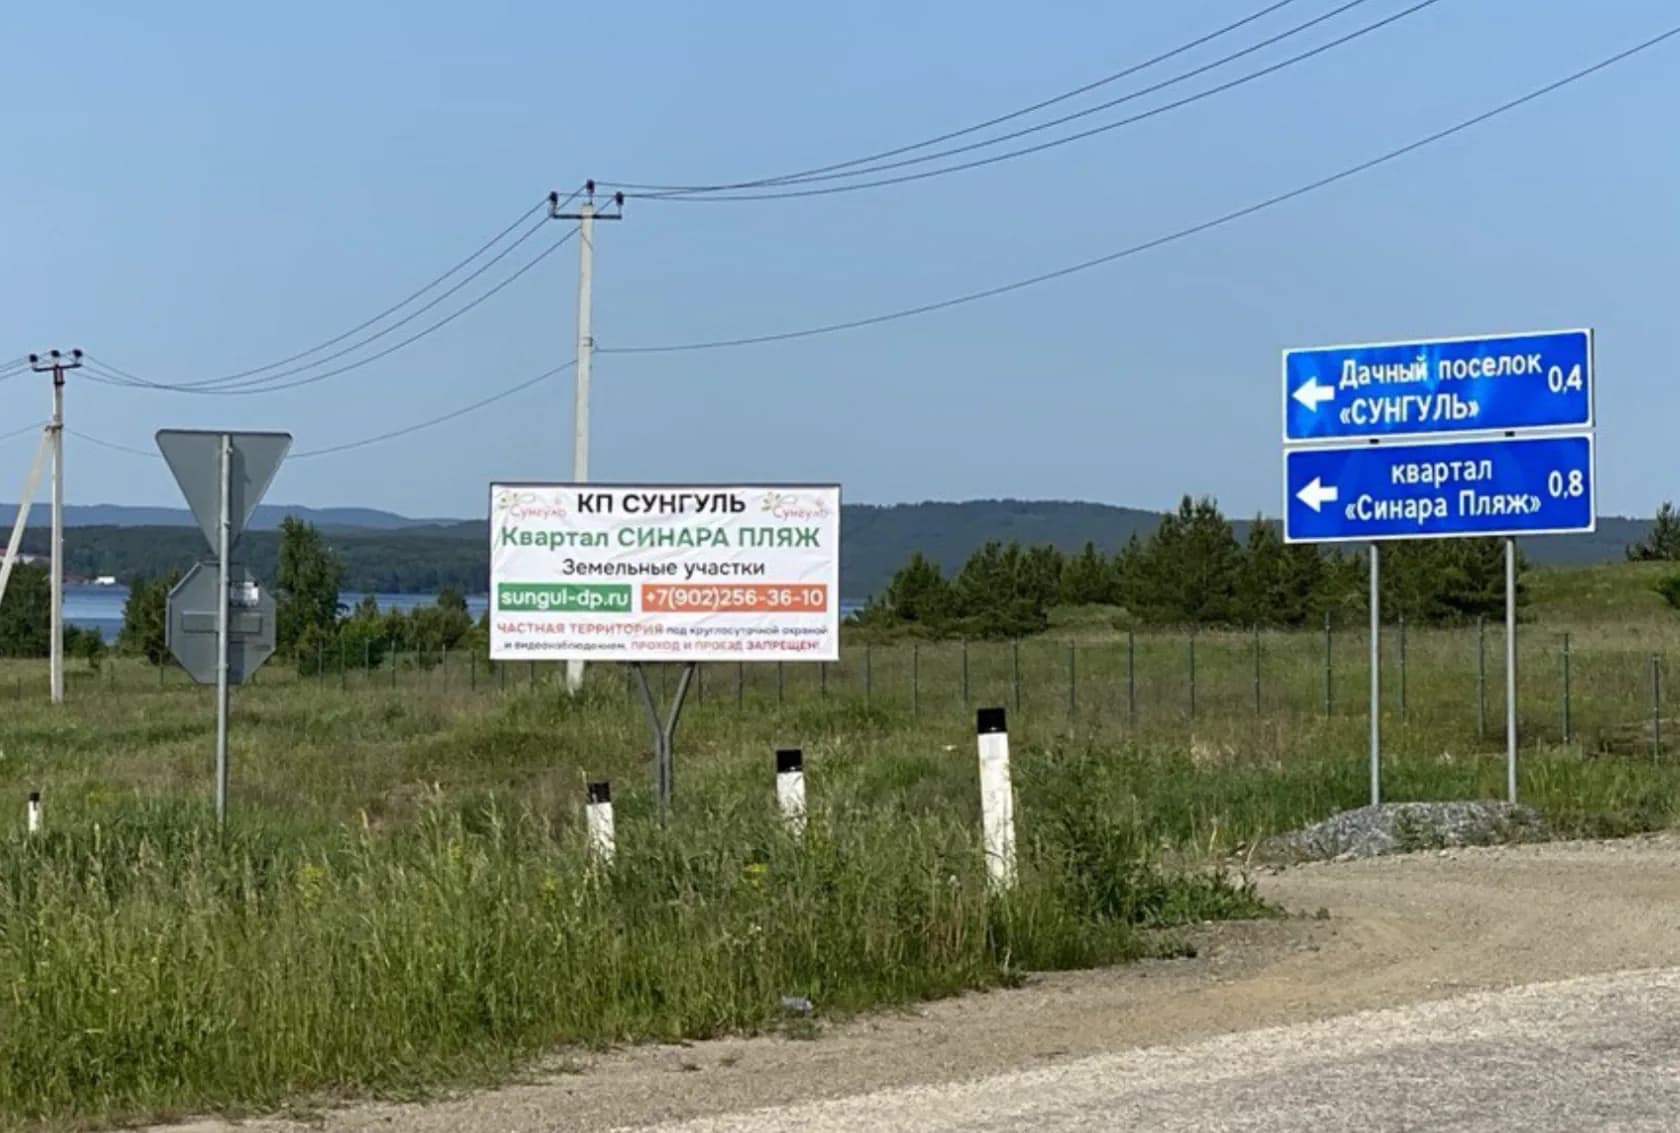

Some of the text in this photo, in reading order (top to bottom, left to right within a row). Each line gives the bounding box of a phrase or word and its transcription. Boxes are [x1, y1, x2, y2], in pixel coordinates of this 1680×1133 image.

[1338, 354, 1543, 390] Дачный поселок
[1547, 364, 1583, 395] 0,4
[1339, 393, 1480, 425] «СУНГУЛЬ»
[1391, 459, 1493, 488] квартал
[1548, 470, 1584, 499] 0,8
[577, 493, 746, 514] КП СУНГУЛЬ
[1345, 489, 1541, 525] «Синара Пляж»
[501, 526, 820, 551] Квартал СИНАРА ПЛЯЖ
[562, 558, 765, 580] Земельные участки
[501, 588, 628, 609] sungul-dp.ru
[645, 587, 824, 610] +7(902)256-36-10
[497, 623, 828, 637] ЧАСТНАЯ ТЕРРИТОРИЯ под круглосуточной охраной
[504, 641, 513, 649] и
[631, 640, 680, 652] ПРОХОД
[683, 640, 692, 650] И
[695, 640, 743, 652] ПРОЕЗД
